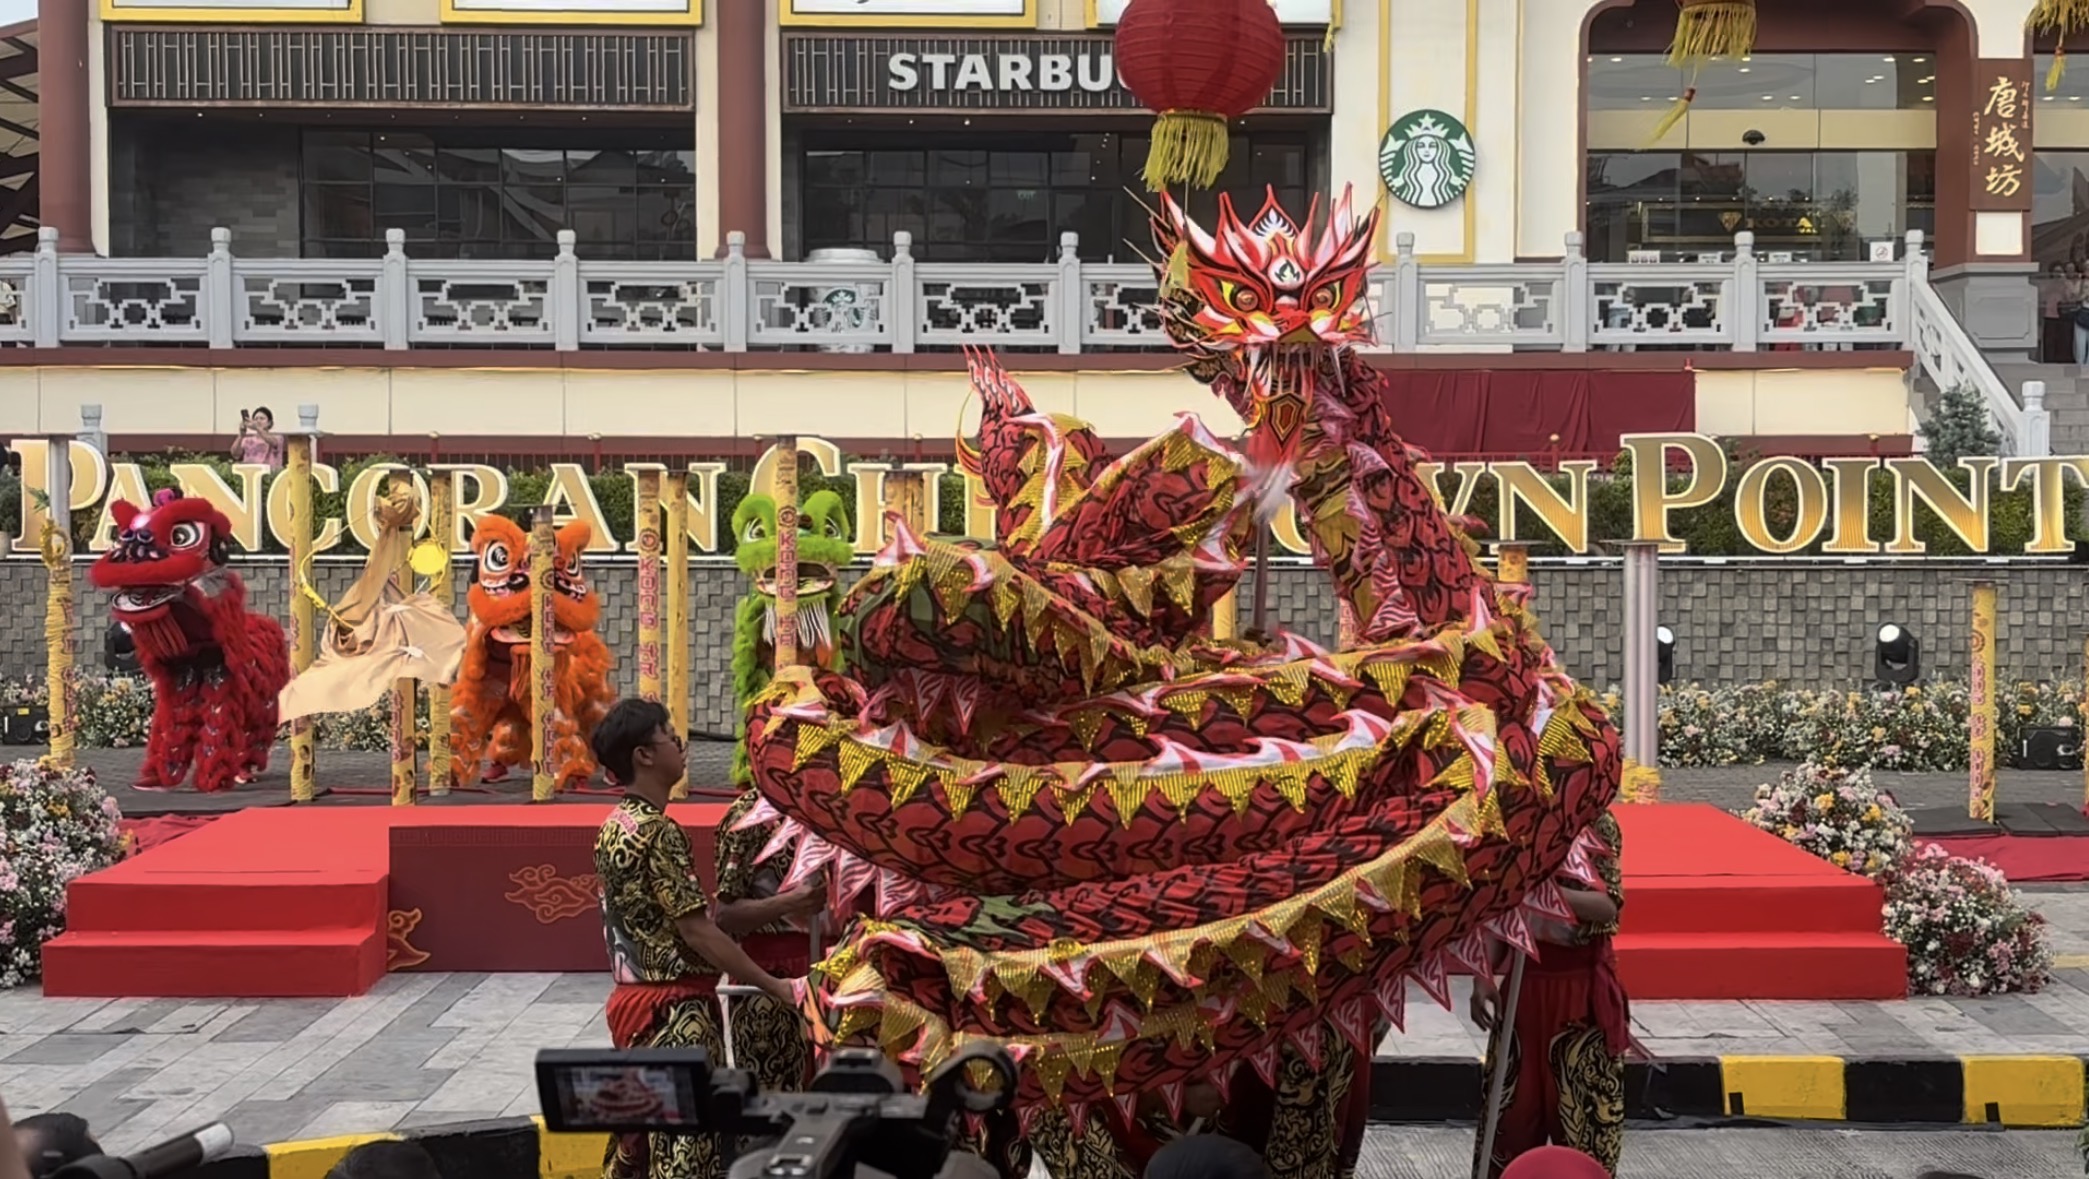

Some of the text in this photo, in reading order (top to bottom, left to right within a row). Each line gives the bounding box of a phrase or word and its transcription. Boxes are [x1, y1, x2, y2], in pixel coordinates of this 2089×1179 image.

[888, 53, 1131, 92] STARBU
[1984, 76, 2025, 197] 唐城坊
[1620, 433, 2089, 554] POINT
